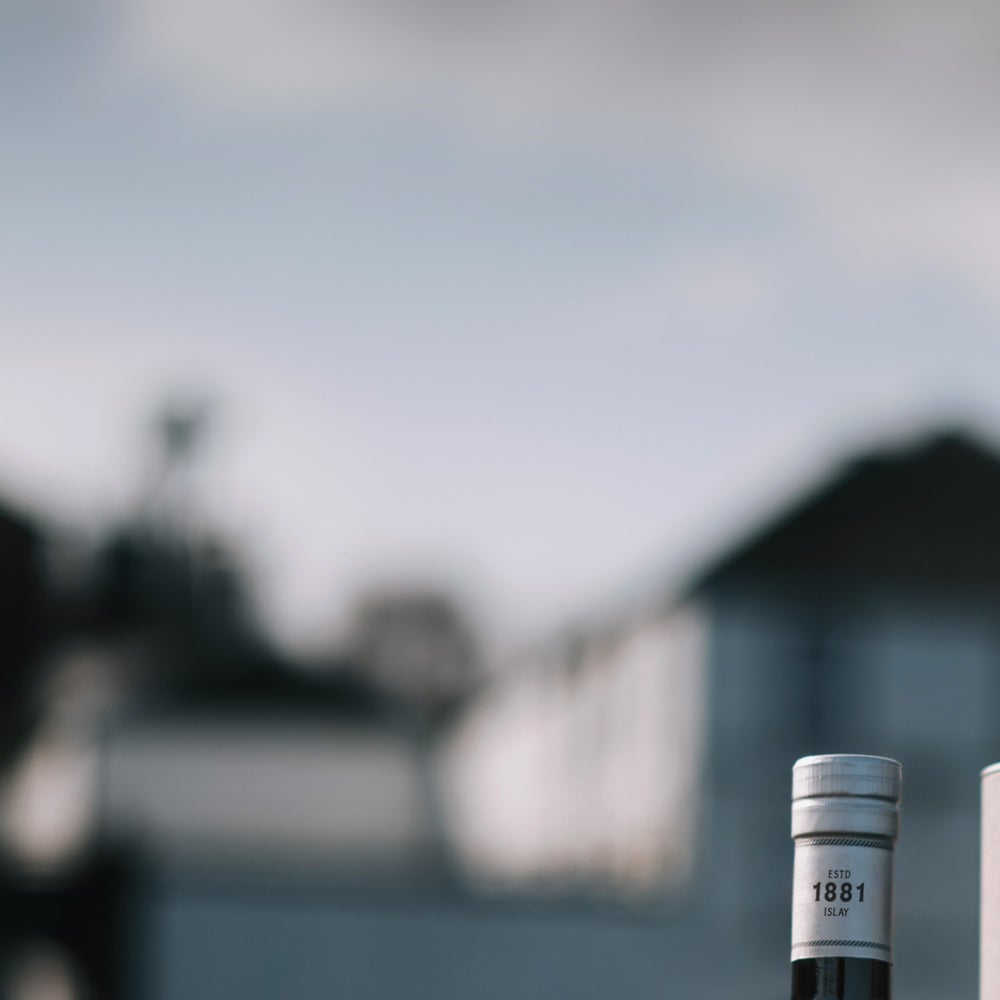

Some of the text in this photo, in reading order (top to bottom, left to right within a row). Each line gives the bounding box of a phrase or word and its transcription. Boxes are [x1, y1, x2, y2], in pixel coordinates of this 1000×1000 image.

[827, 868, 852, 880] ESTD
[812, 881, 865, 903] 1881
[823, 906, 850, 917] ISLAY
